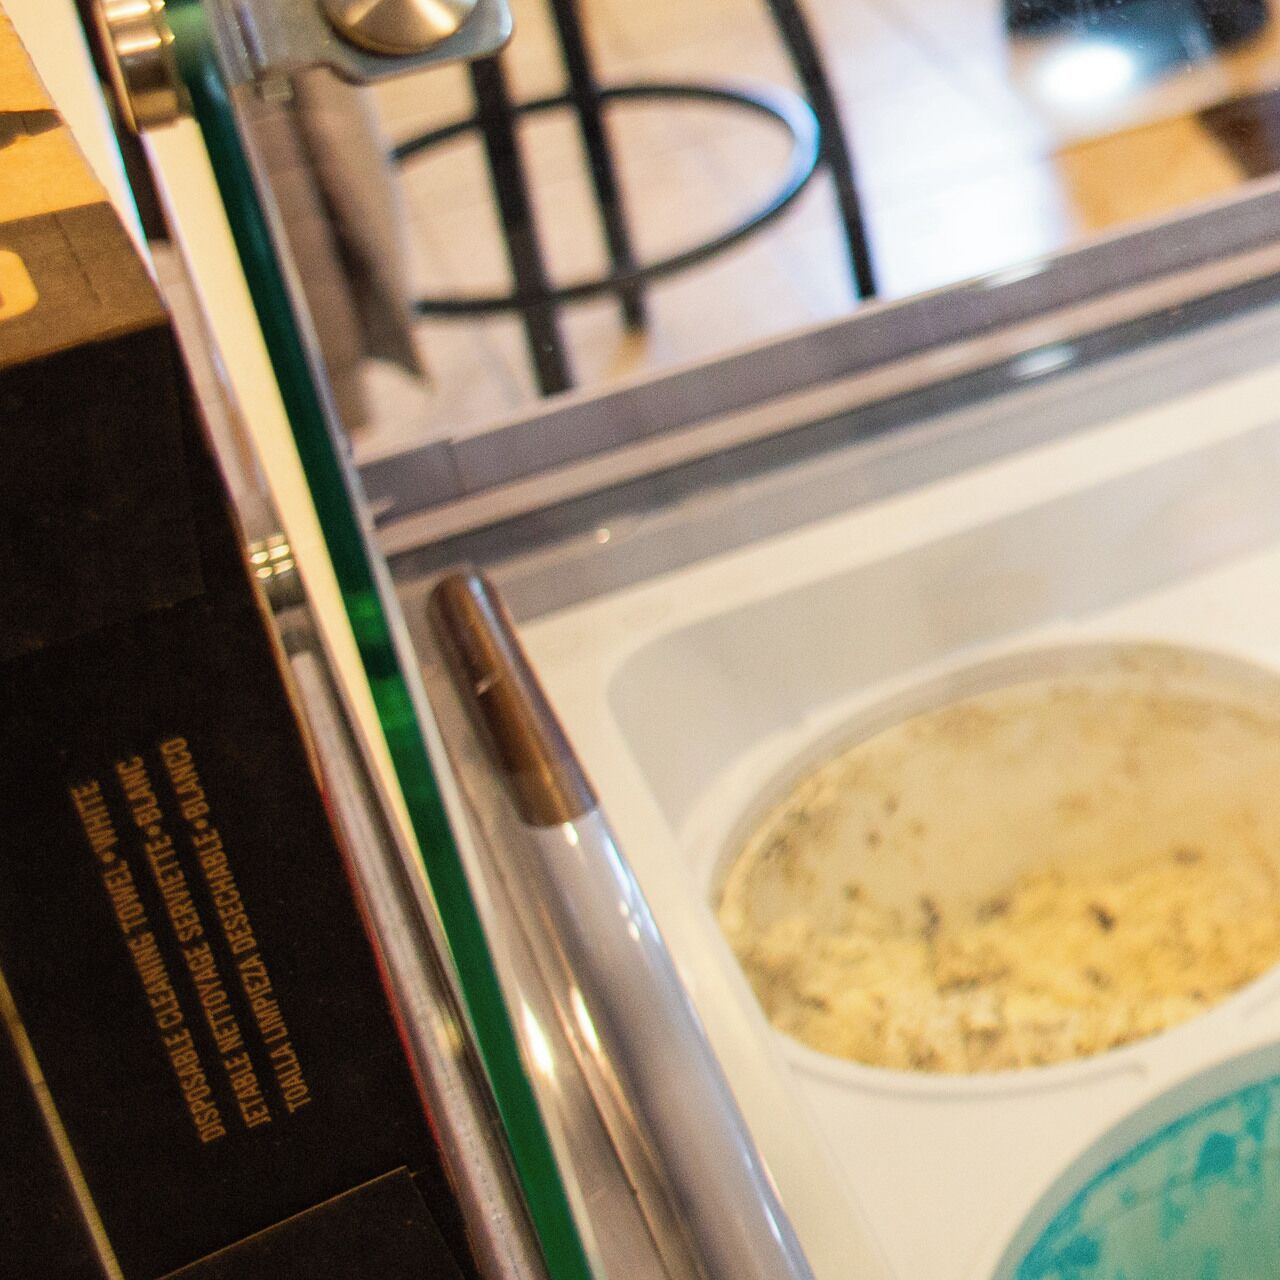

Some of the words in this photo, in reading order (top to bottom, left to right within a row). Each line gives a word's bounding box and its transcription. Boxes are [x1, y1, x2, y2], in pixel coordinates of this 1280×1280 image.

[130, 933, 184, 1029] CLEANING
[188, 942, 242, 1052] NETTOYAGE
[240, 952, 289, 1043] LIMPIEZA
[159, 1029, 227, 1144] DISPOSABLE
[225, 1054, 272, 1129] JETABLE
[269, 1041, 313, 1113] TOALLA
